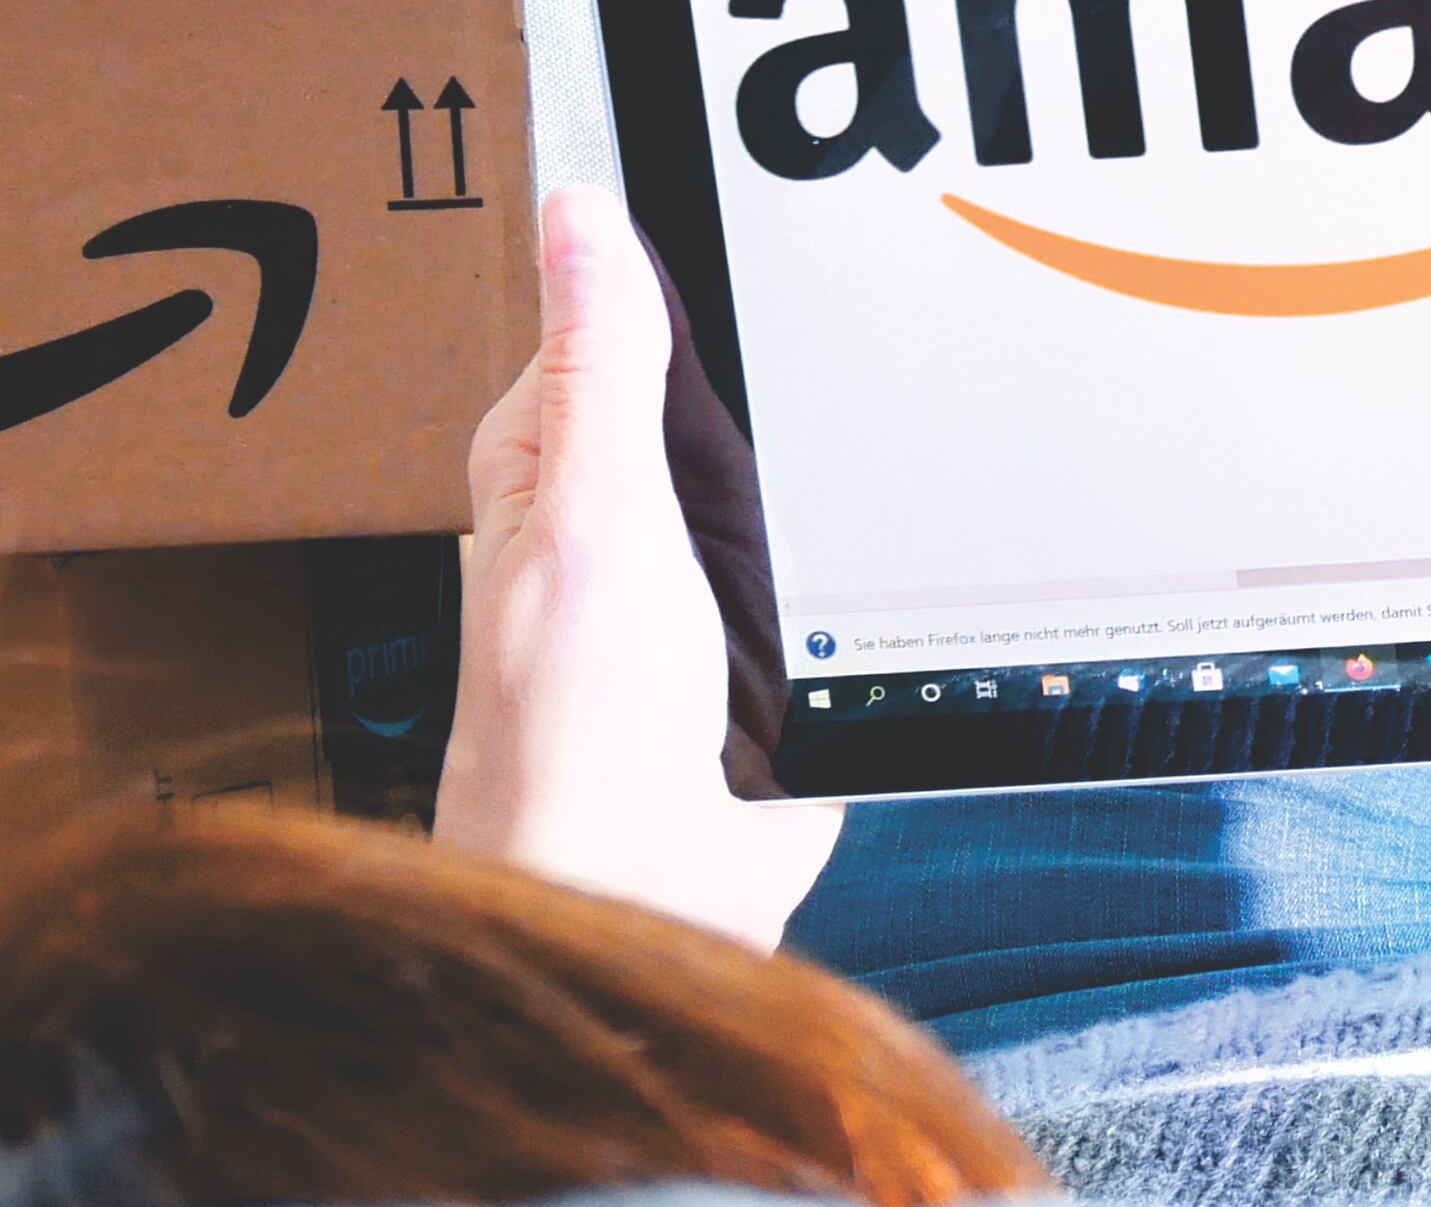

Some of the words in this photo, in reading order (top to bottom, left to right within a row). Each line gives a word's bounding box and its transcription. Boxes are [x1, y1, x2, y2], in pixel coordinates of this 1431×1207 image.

[853, 637, 876, 652] Sie
[879, 635, 924, 650] haben
[928, 631, 976, 647] Firefox
[979, 629, 1021, 646] lange
[1023, 627, 1060, 641] nicht
[1063, 623, 1100, 638] mehr
[1104, 621, 1163, 640] genutzt.
[1167, 618, 1193, 632] Soll
[1196, 617, 1228, 634] jetzt
[1233, 611, 1316, 631] aufgeräumt
[1319, 608, 1377, 623] werden,
[1381, 605, 1422, 620] damit
